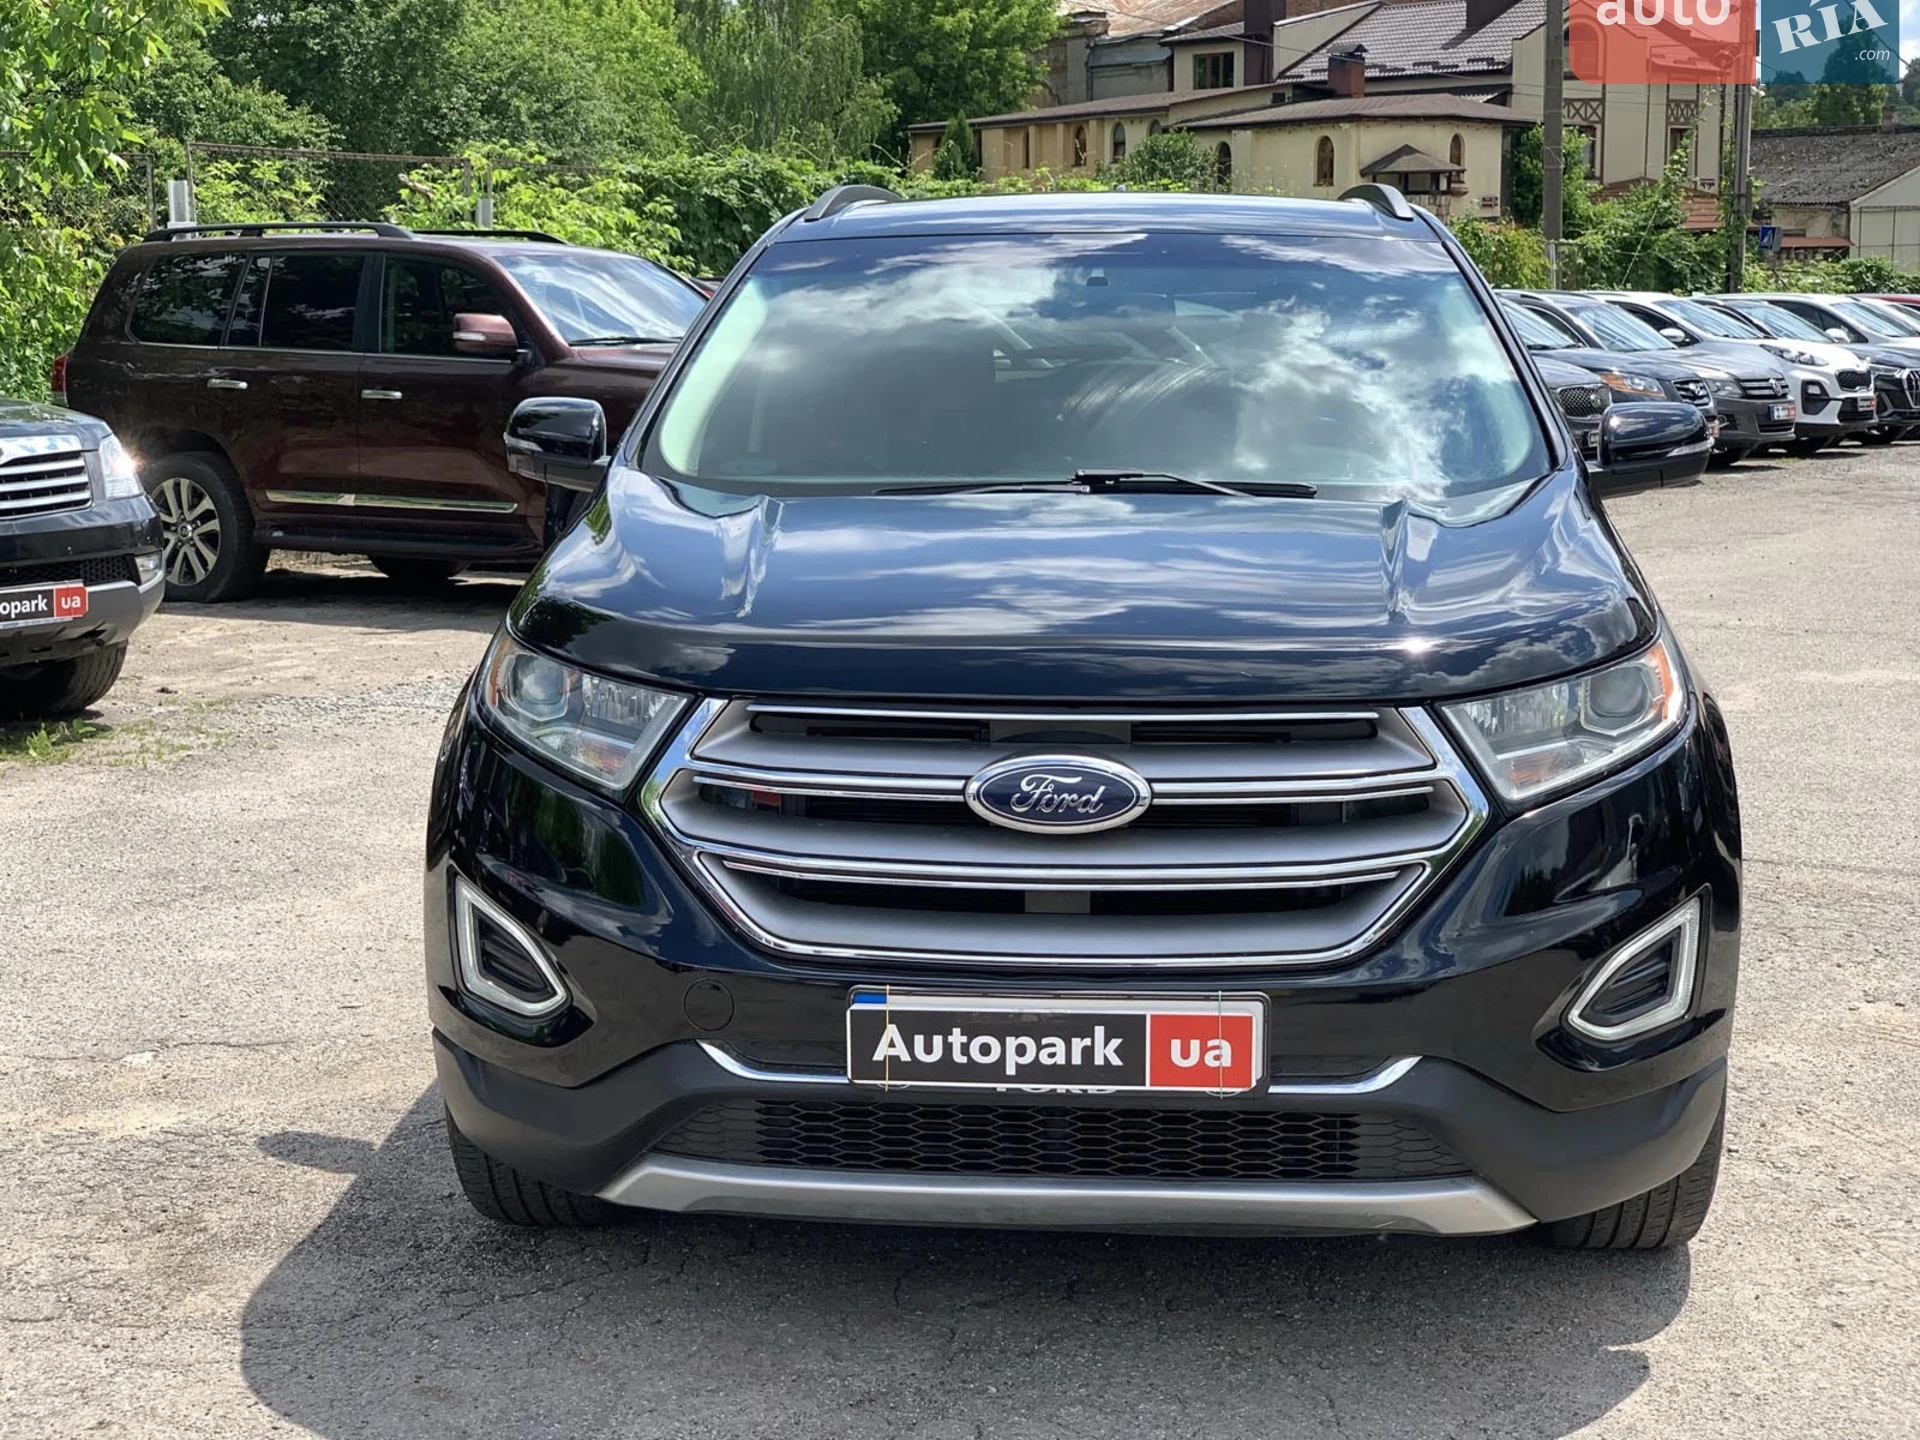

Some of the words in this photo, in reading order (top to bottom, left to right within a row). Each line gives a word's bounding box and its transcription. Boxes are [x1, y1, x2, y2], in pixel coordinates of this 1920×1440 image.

[61, 595, 81, 609] ua
[1010, 773, 1106, 813] Ford
[872, 1024, 1124, 1076] Autopark
[1170, 1038, 1232, 1068] ua
